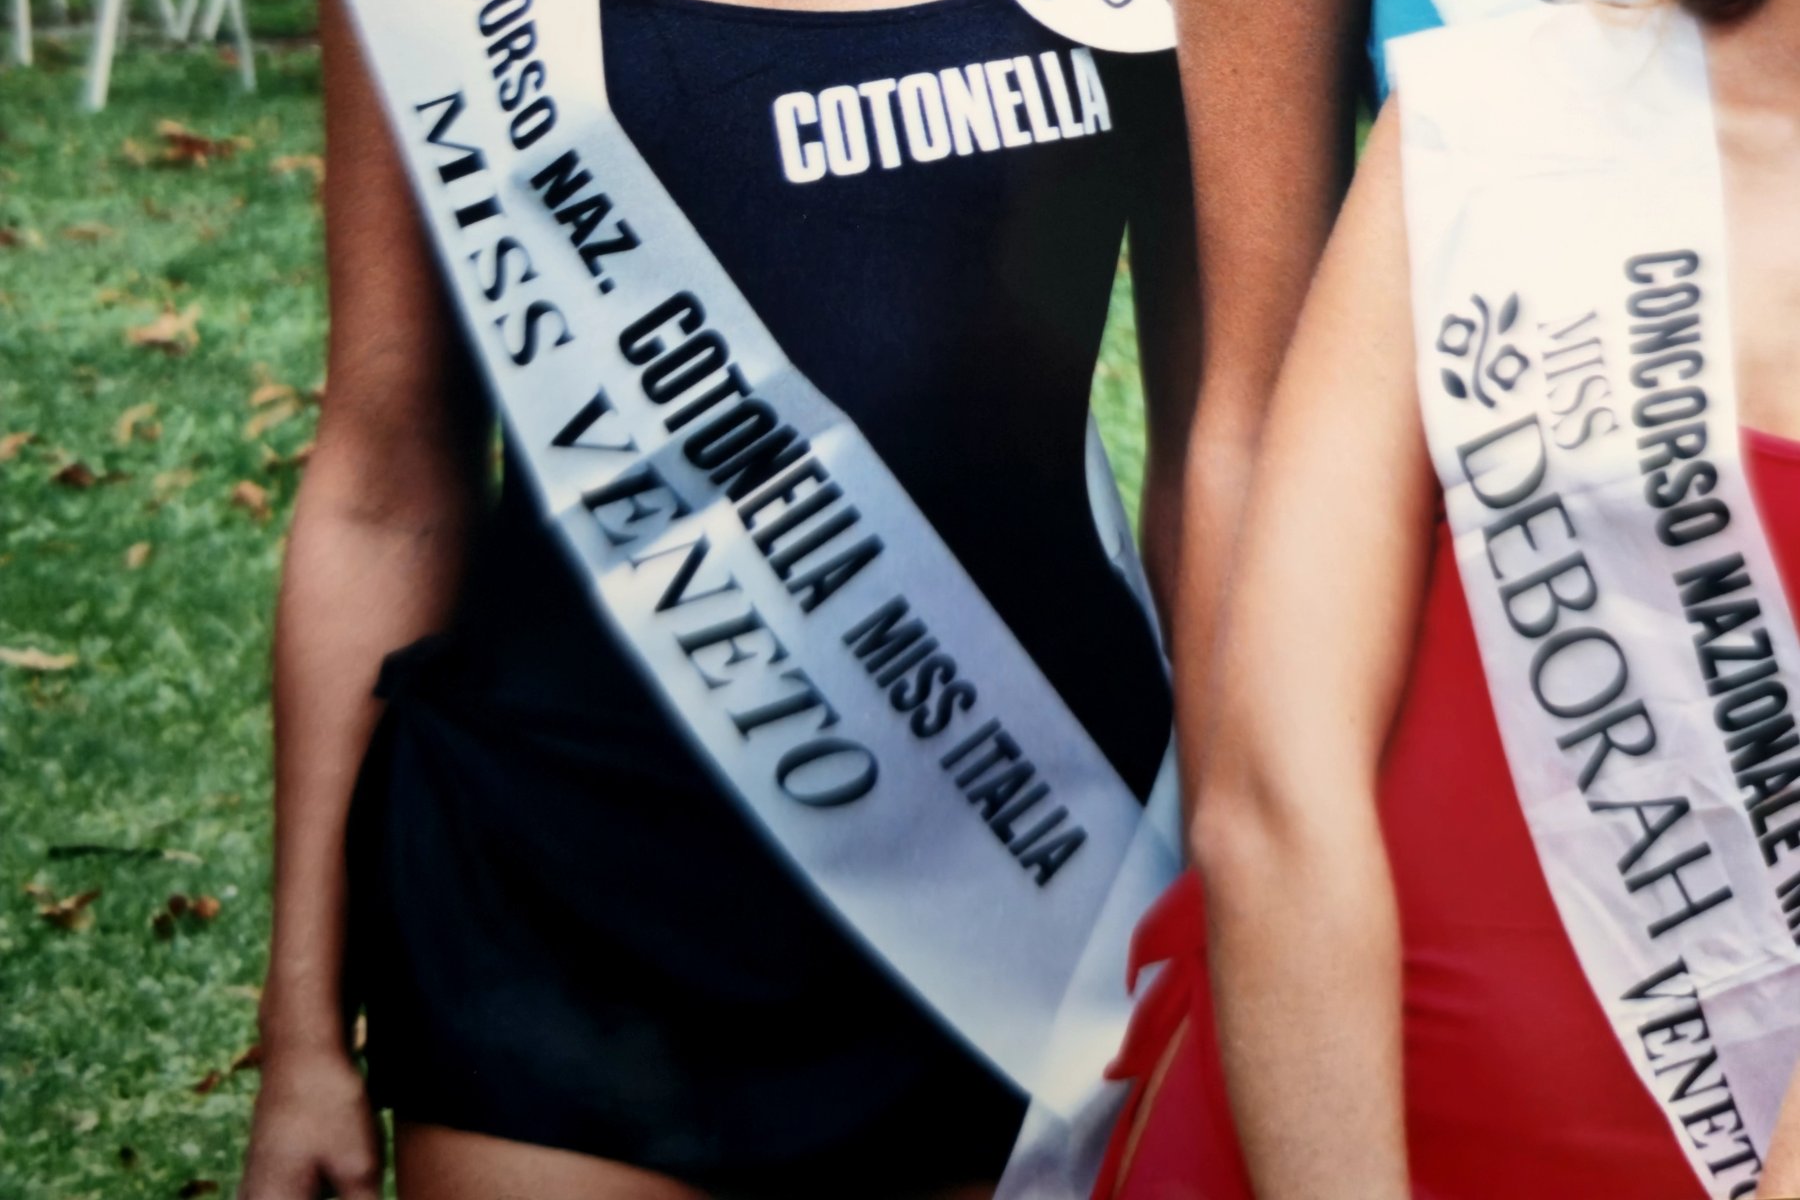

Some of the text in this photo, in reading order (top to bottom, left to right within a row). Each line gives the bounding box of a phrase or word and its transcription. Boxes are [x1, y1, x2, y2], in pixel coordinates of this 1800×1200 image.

[415, 90, 879, 808] MISS VENETO
[772, 47, 1113, 185] COTONELLA
[1537, 310, 1620, 451] MISS
[529, 148, 642, 295] NAZ.
[618, 289, 886, 615] COTONELLA
[841, 595, 978, 740] MISS
[939, 717, 1089, 887] ITALIA
[1455, 411, 1764, 1198] DEBORAH VENET
[1623, 249, 1800, 868] CONCORSO NAZIONALE
